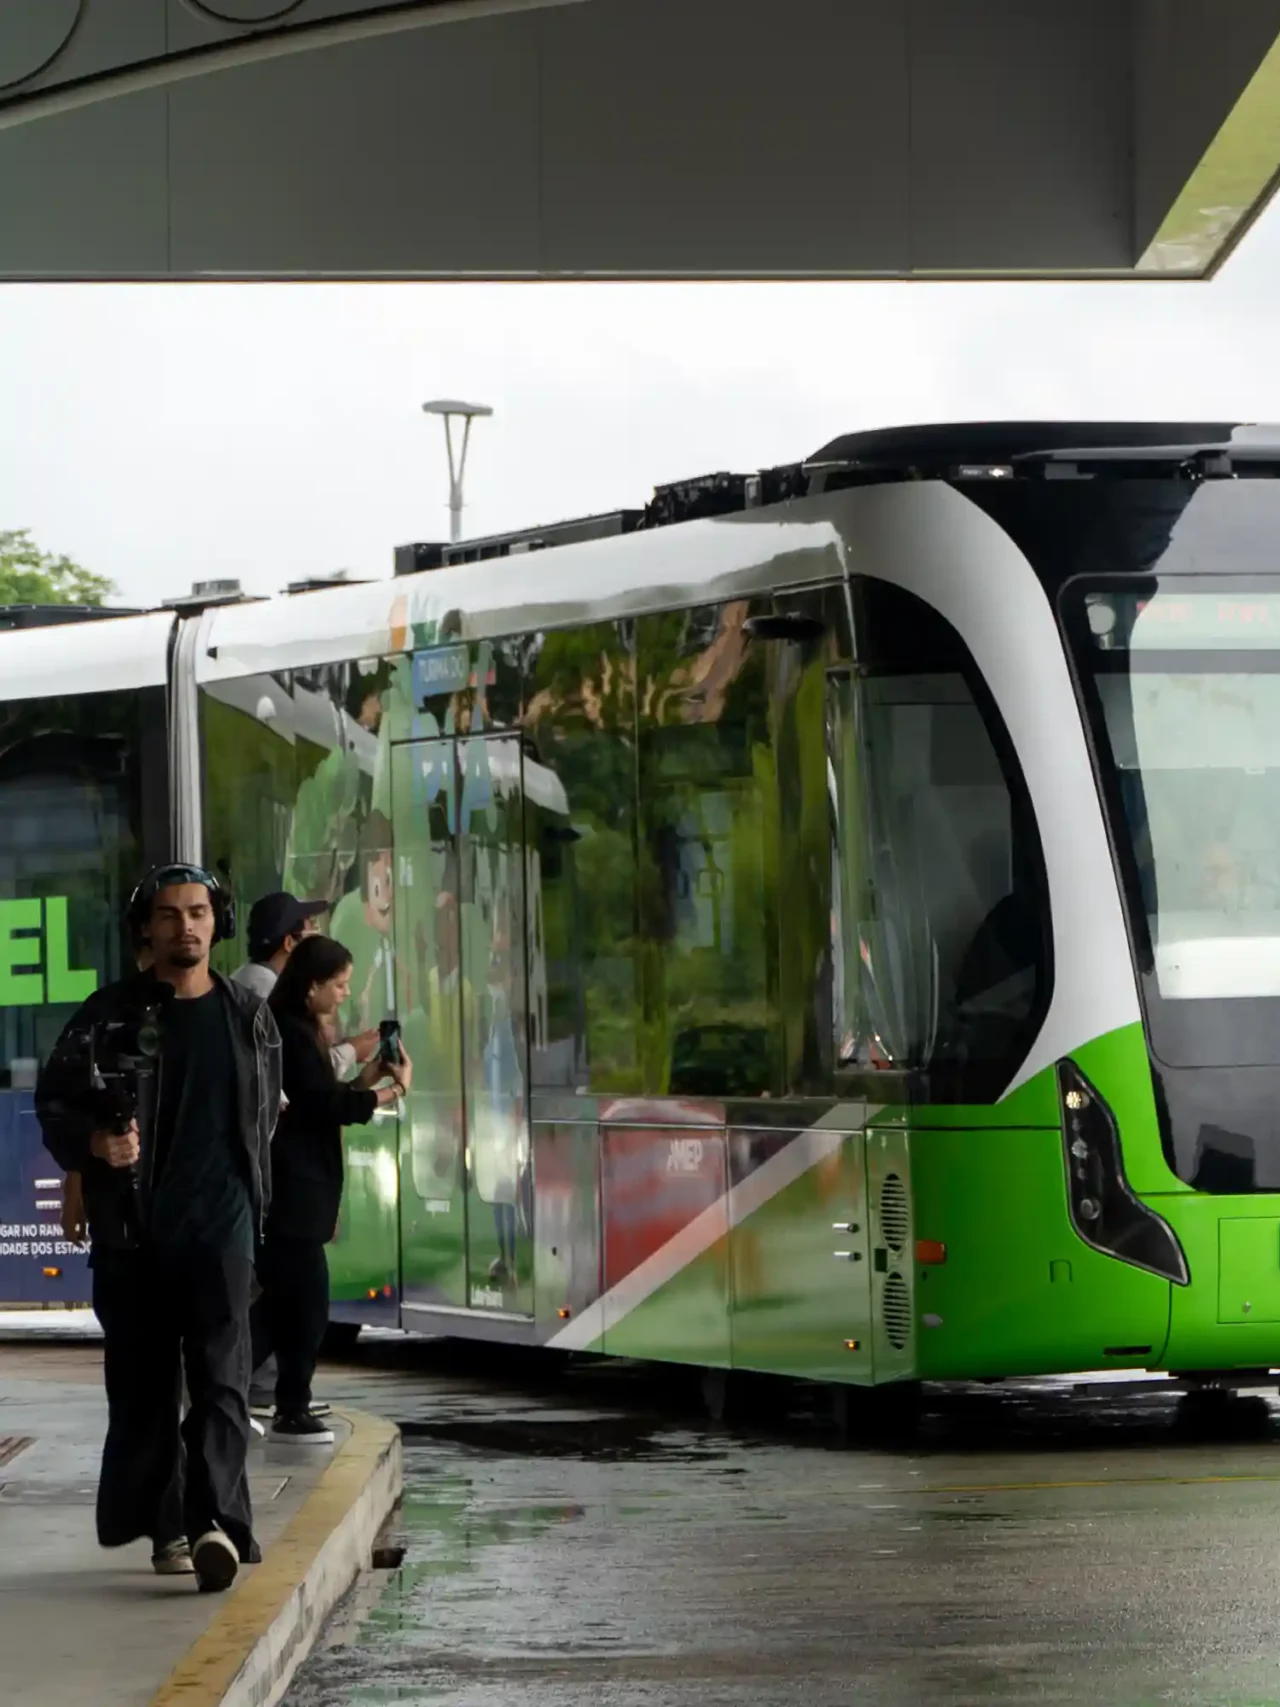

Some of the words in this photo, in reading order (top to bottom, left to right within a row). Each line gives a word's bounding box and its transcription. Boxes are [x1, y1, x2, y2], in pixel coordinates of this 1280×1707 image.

[0, 896, 97, 1006] EL
[0, 1223, 20, 1238] GAR
[22, 1223, 37, 1237] NO
[31, 1241, 52, 1255] DOS
